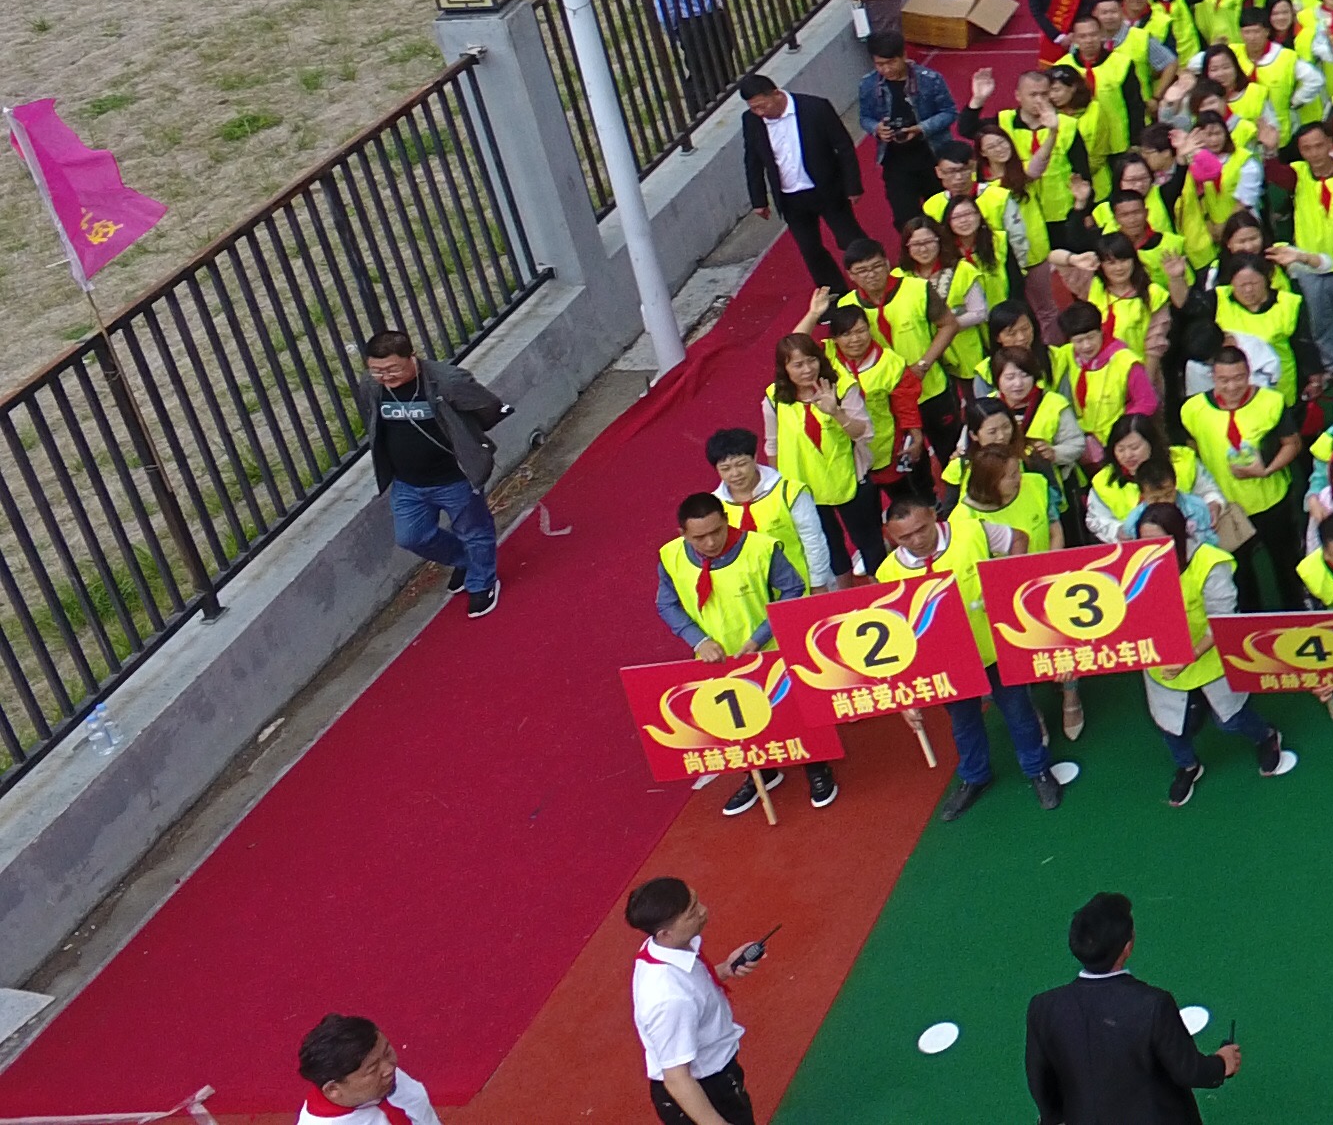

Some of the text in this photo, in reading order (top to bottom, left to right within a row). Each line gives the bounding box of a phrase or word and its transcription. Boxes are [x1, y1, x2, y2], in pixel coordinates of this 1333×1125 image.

[380, 404, 425, 418] Calvin
[1065, 583, 1104, 628] 3
[856, 621, 900, 668] 2
[1032, 638, 1161, 677] 尚赫爱心车队
[1295, 635, 1333, 662] 4
[714, 689, 746, 729] 1
[831, 671, 958, 719] 尚赫爱心车队
[683, 738, 811, 775] 尚赫爱心车队
